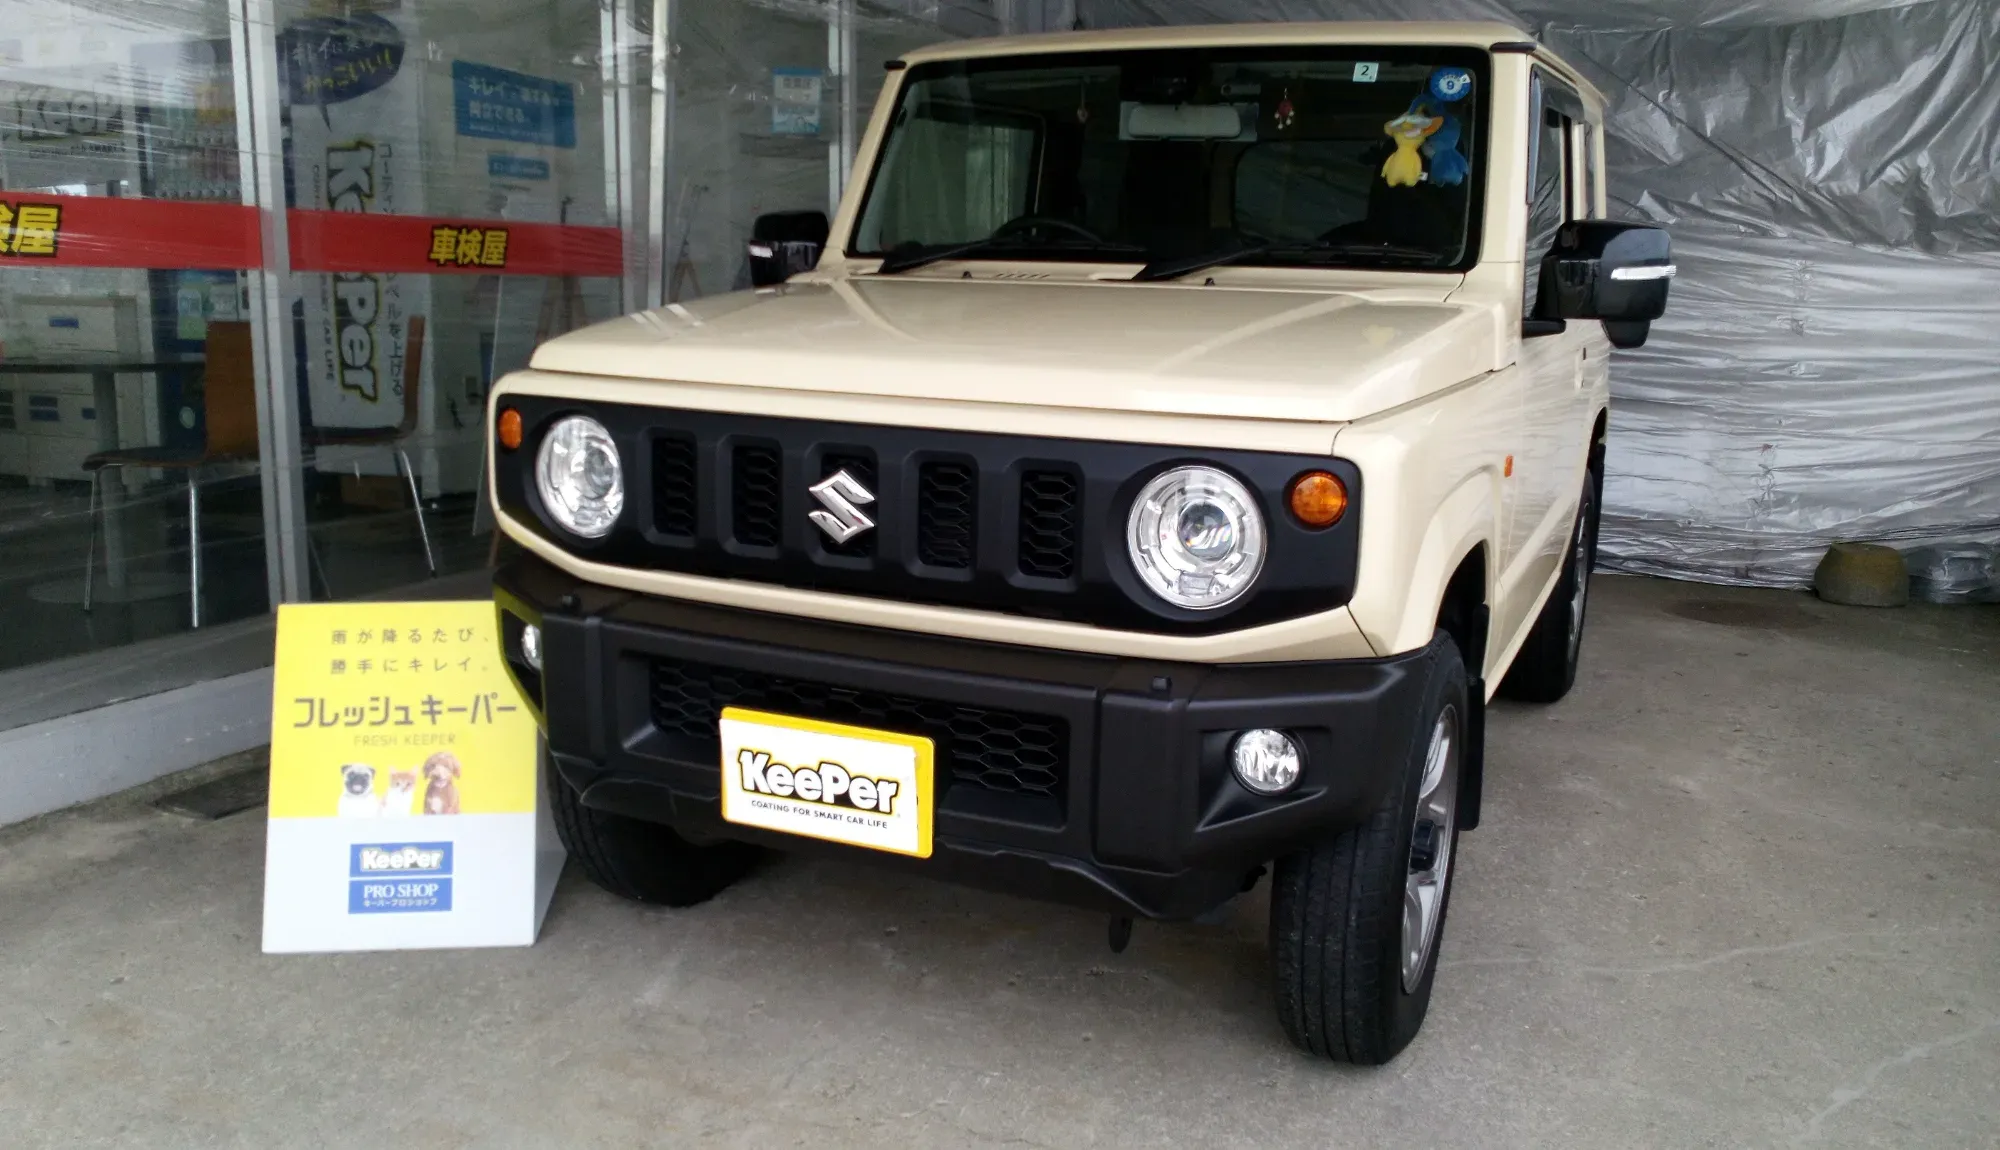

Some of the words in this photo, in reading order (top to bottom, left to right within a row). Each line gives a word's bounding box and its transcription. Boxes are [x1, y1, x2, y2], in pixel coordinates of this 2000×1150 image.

[1361, 65, 1370, 76] 2
[428, 225, 509, 267] 車検屋
[331, 627, 490, 645] 雨が降るたび、
[331, 656, 488, 675] 勝手にキレイ。
[293, 691, 518, 728] フレッシュキーパー
[353, 734, 398, 748] FRESH
[403, 733, 456, 747] KEEPER
[738, 748, 900, 815] KeePer
[751, 799, 790, 813] COATING
[793, 806, 811, 817] FOR
[814, 810, 843, 822] SMART
[847, 815, 864, 825] CAR
[867, 819, 888, 829] LIFE
[361, 847, 444, 871] KeePer
[363, 884, 395, 899] PRO
[397, 883, 439, 897] SHOP
[363, 898, 438, 907] キーパープロショップ
